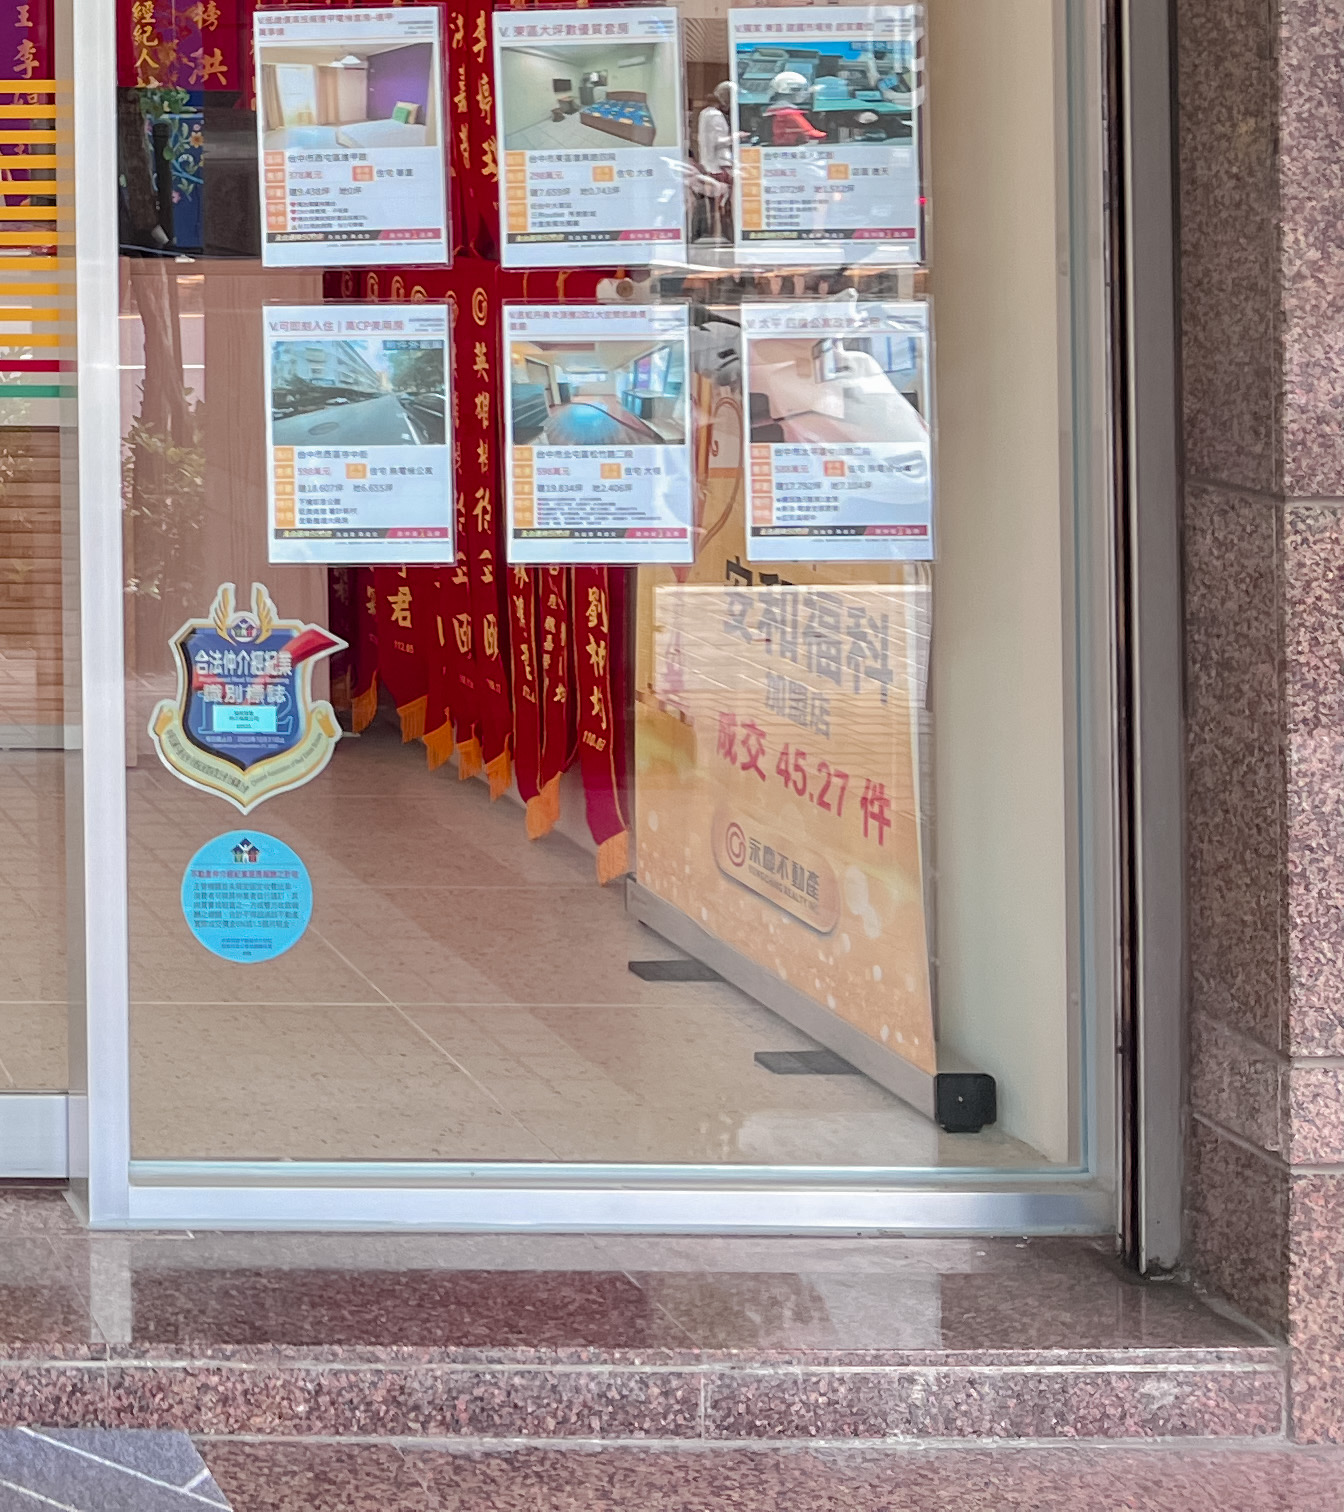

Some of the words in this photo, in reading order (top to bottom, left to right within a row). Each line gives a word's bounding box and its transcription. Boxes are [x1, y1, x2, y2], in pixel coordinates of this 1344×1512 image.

[716, 711, 767, 783] 成交
[776, 742, 849, 818] 45.27
[859, 778, 893, 848] 件
